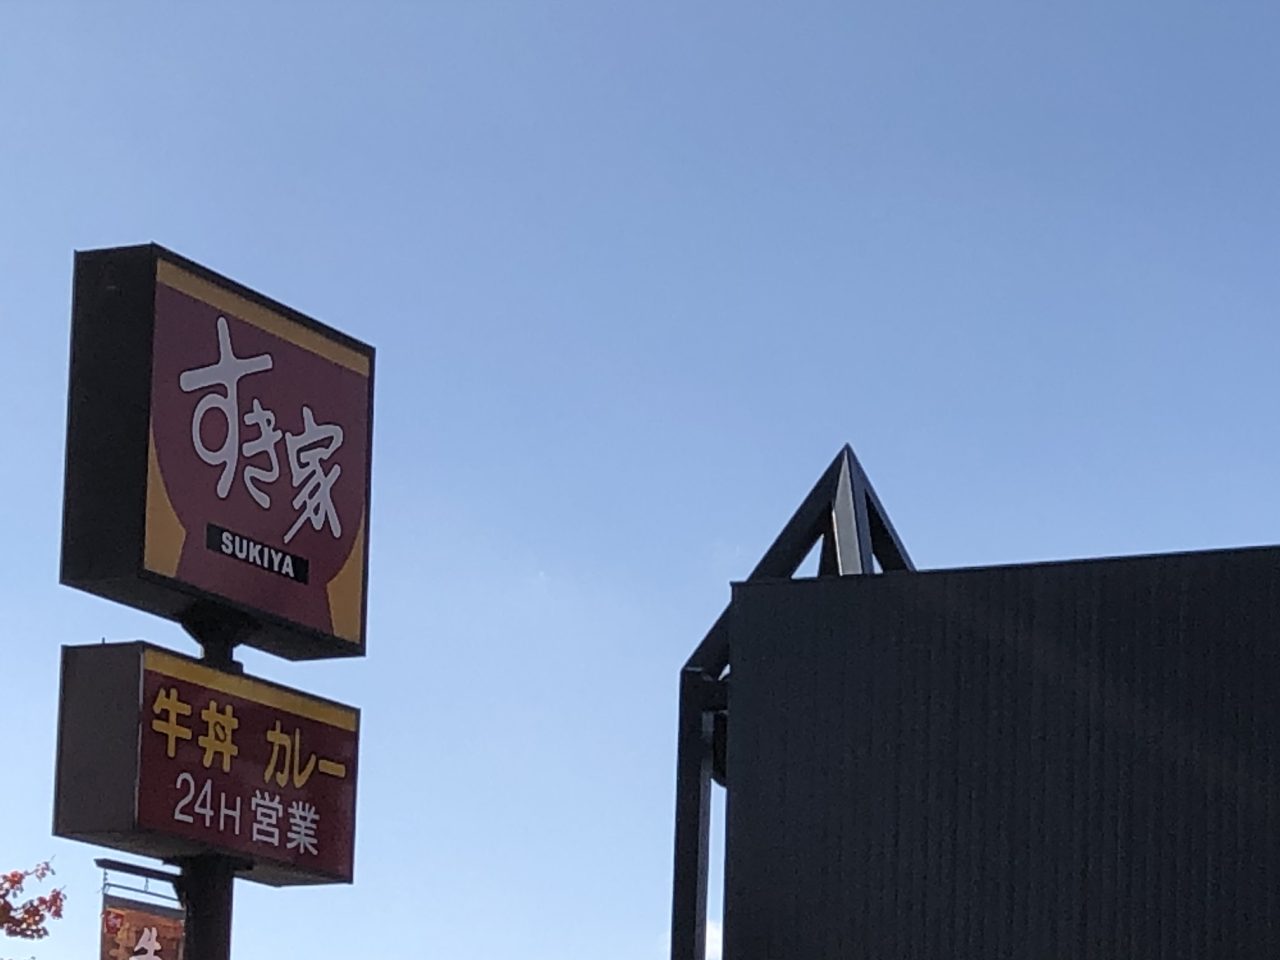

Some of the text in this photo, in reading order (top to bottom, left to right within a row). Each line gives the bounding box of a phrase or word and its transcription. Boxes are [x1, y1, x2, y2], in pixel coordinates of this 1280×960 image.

[179, 315, 345, 544] すき家
[219, 530, 296, 578] SUKIYA
[151, 686, 347, 792] 牛丼 カレー
[173, 772, 321, 857] 24H営業
